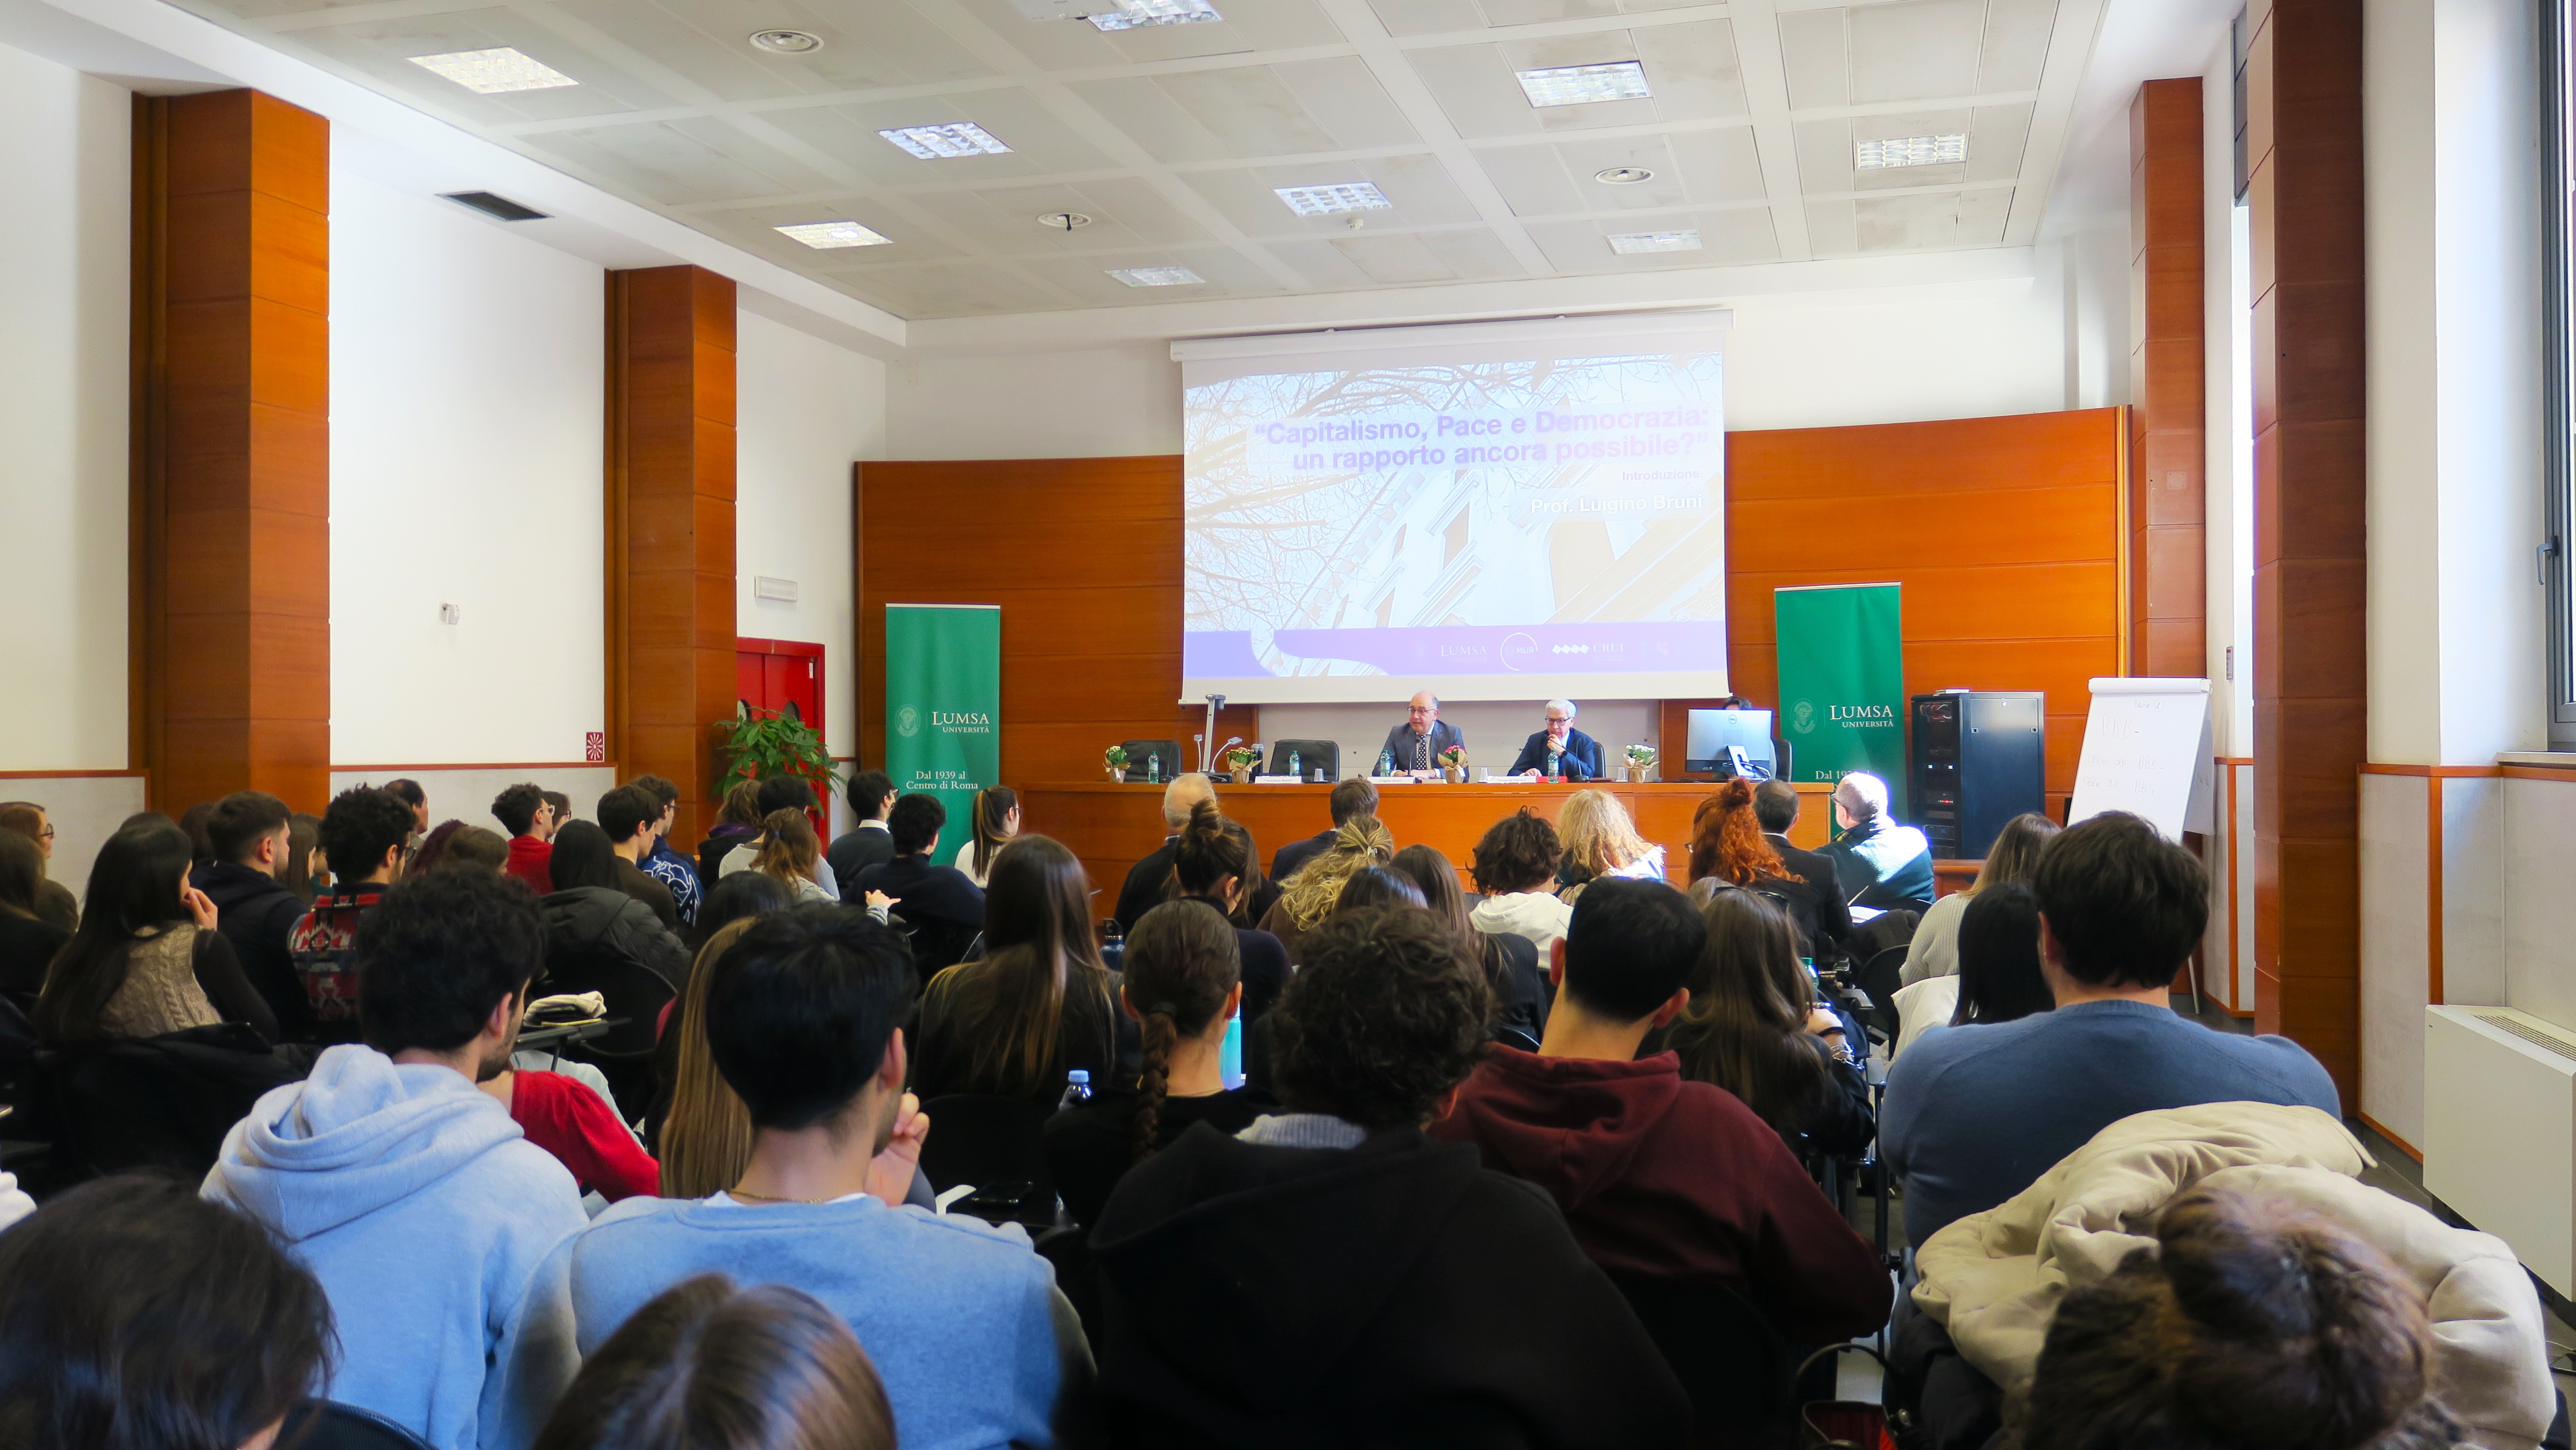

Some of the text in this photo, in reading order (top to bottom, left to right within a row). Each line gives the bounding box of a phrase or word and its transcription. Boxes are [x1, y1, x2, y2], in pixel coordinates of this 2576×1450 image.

[1437, 415, 1502, 436] Pace
[1511, 417, 1526, 434] e
[1536, 405, 1708, 433] Democrazia:
[1293, 452, 1323, 470] un
[1333, 445, 1445, 472] rapporto
[1454, 443, 1546, 463] ancora
[1622, 469, 1700, 481] Introduzione
[1531, 493, 1703, 514] Prof. Luigino Bruni
[1593, 643, 1624, 653] CRUI
[932, 711, 990, 725] LUMSA
[1830, 705, 1893, 720] LUMSA
[1842, 719, 1893, 728] UNIVERSITÀ
[915, 771, 966, 780] Dal 1939 al
[1815, 770, 1832, 780] Dal
[906, 781, 978, 789] Centro di Roma
